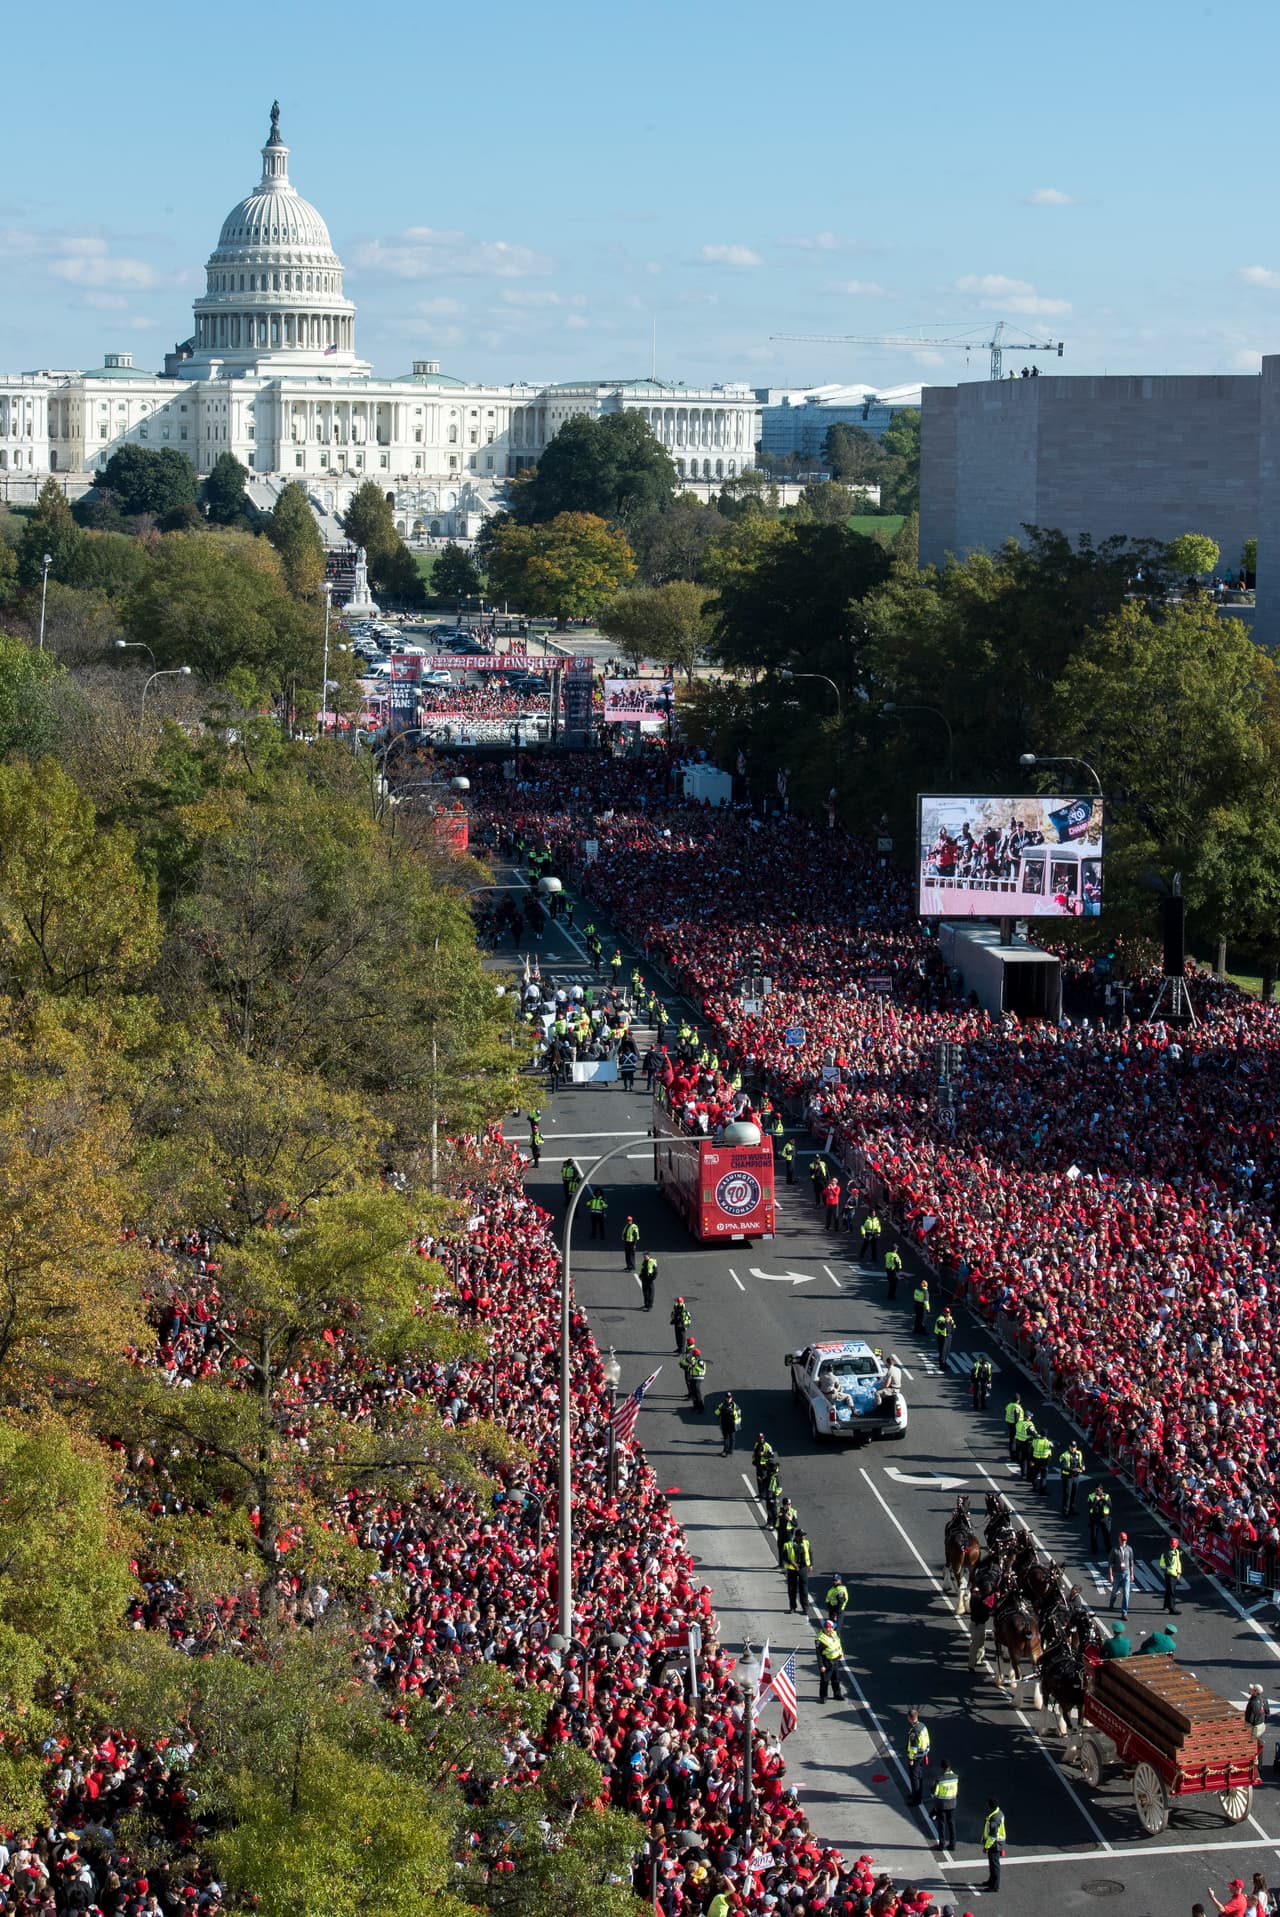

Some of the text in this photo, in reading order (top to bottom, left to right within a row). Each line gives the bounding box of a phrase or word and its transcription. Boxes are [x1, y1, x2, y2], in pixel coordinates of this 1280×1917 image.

[466, 657, 501, 668] FIGHT
[503, 657, 558, 668] FINISHED
[730, 1160, 772, 1168] CHAMPIONS
[720, 1200, 756, 1214] NATIONALS
[740, 1222, 761, 1230] BANK
